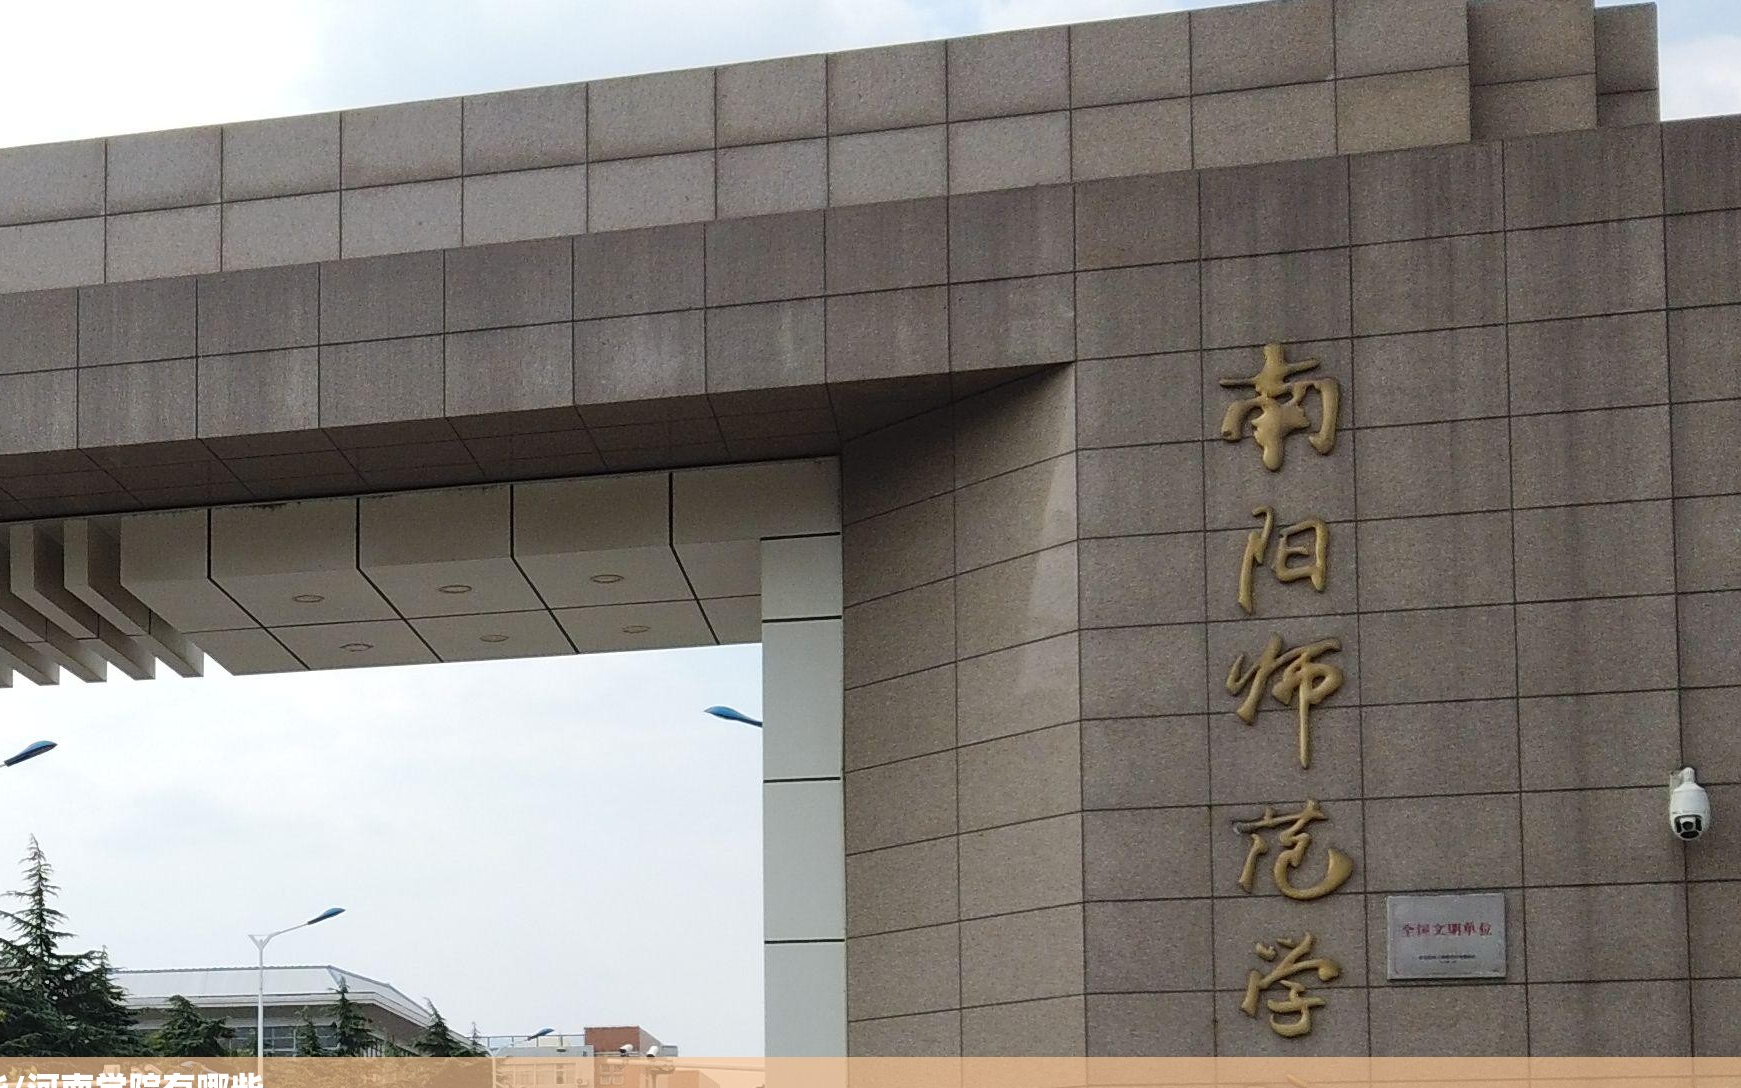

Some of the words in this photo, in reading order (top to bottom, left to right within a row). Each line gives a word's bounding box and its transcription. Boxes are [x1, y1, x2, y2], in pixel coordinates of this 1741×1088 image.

[1402, 921, 1493, 937] 全国文明单位
